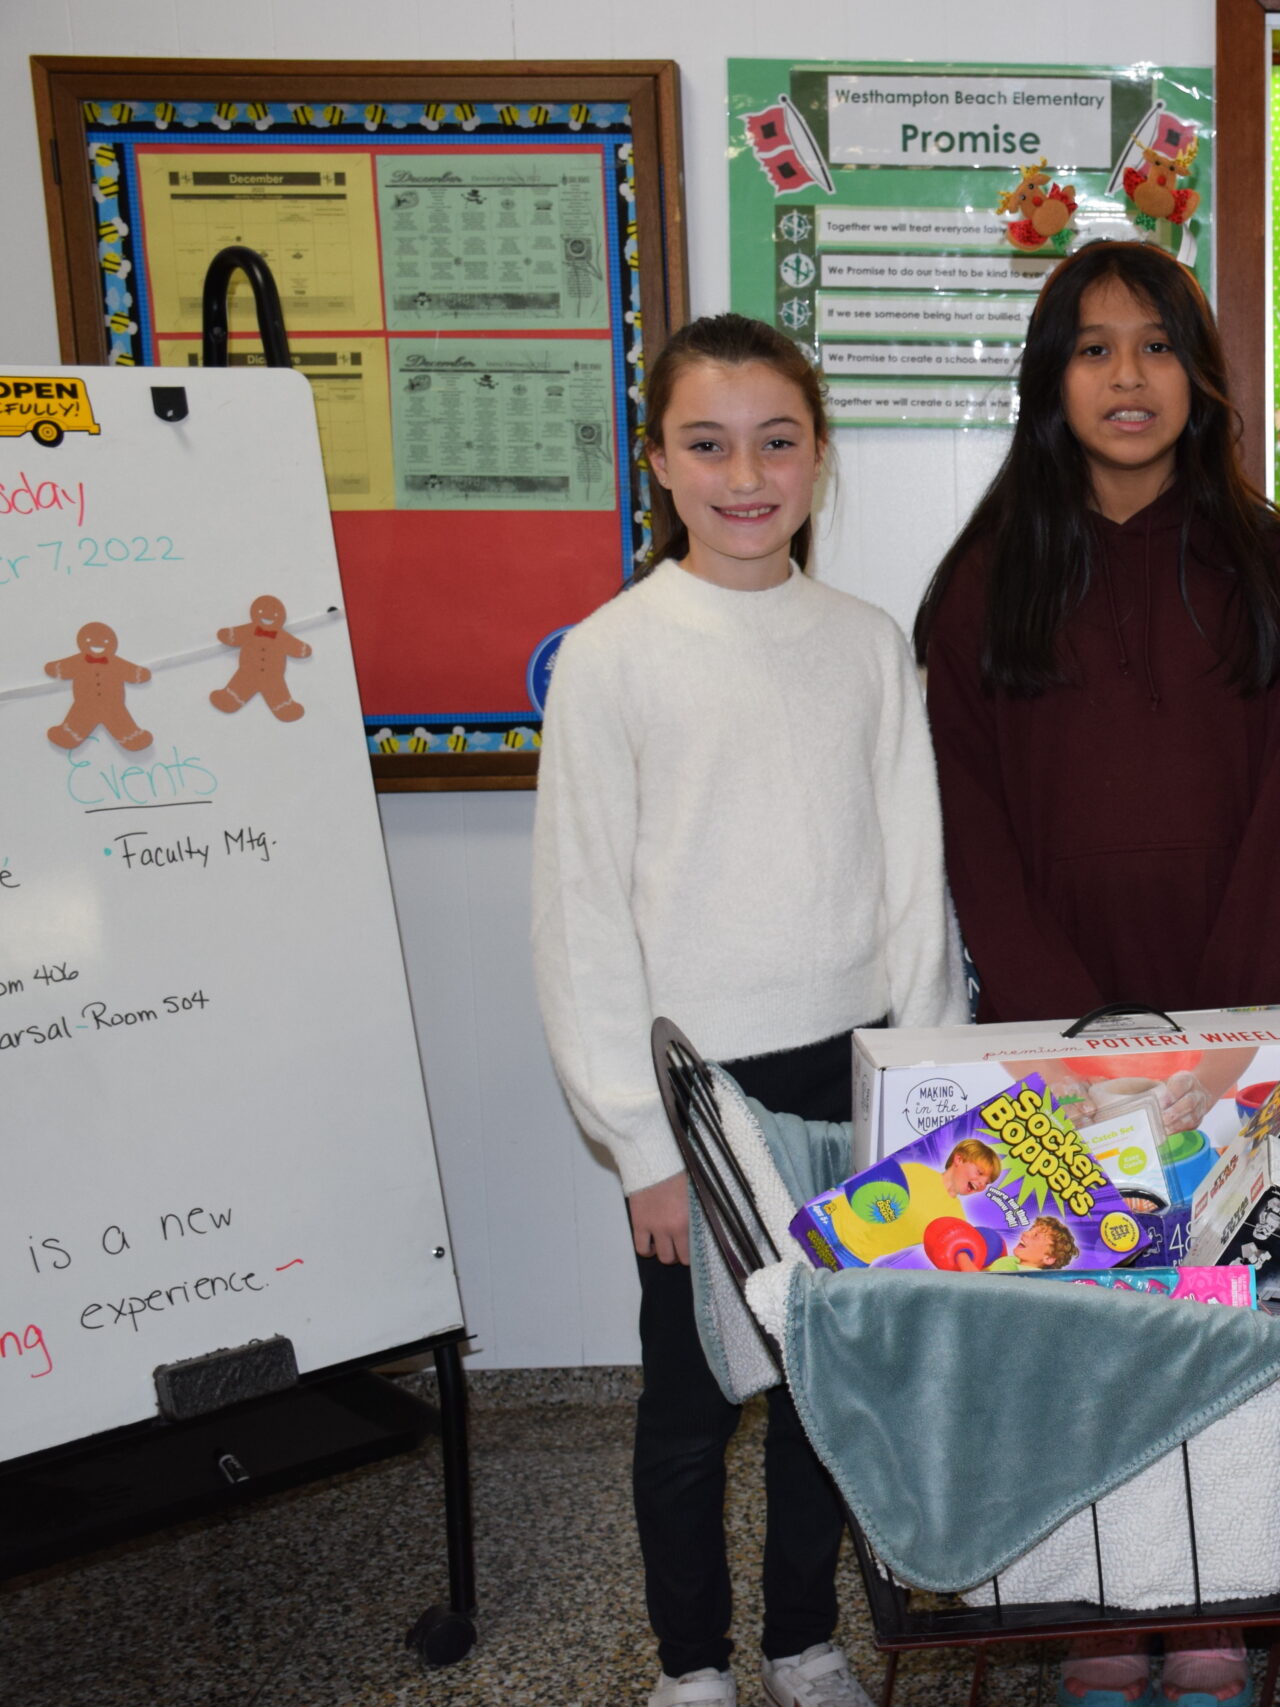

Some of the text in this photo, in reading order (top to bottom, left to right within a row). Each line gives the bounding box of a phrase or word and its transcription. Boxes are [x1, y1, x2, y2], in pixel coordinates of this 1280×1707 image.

[835, 89, 1104, 110] Westhampton Beach Elementary
[901, 123, 1041, 155] Promise
[229, 174, 284, 184] December
[390, 170, 463, 184] December
[827, 222, 871, 233] Together
[890, 222, 906, 232] will
[909, 223, 931, 233] treat
[934, 225, 980, 236] everyone
[828, 266, 1020, 278] We Promise to do our best to be kind to
[828, 309, 834, 317] If
[854, 311, 872, 319] see
[874, 311, 921, 320] someone
[923, 310, 951, 322] being
[954, 312, 973, 321] hurt
[975, 313, 985, 321] or
[404, 355, 476, 368] December
[828, 354, 844, 362] We
[847, 354, 885, 363] Promise
[888, 355, 898, 363] to
[900, 355, 933, 363] create
[945, 356, 977, 364] school
[980, 356, 1009, 365] where
[0, 401, 79, 417] FULLY!
[829, 398, 872, 408] Together
[892, 398, 908, 407] will
[910, 399, 943, 407] create
[66, 735, 217, 804] Events
[114, 826, 277, 868] Faculty Mtg.
[33, 962, 79, 985] 406
[982, 1046, 1083, 1060] premium
[1086, 1034, 1190, 1050] POTTERY
[919, 1086, 954, 1101] MAKING
[916, 1099, 958, 1114] in the
[1012, 1089, 1107, 1187] Socker
[979, 1096, 1095, 1216] Boppers
[29, 1208, 232, 1273] is a new
